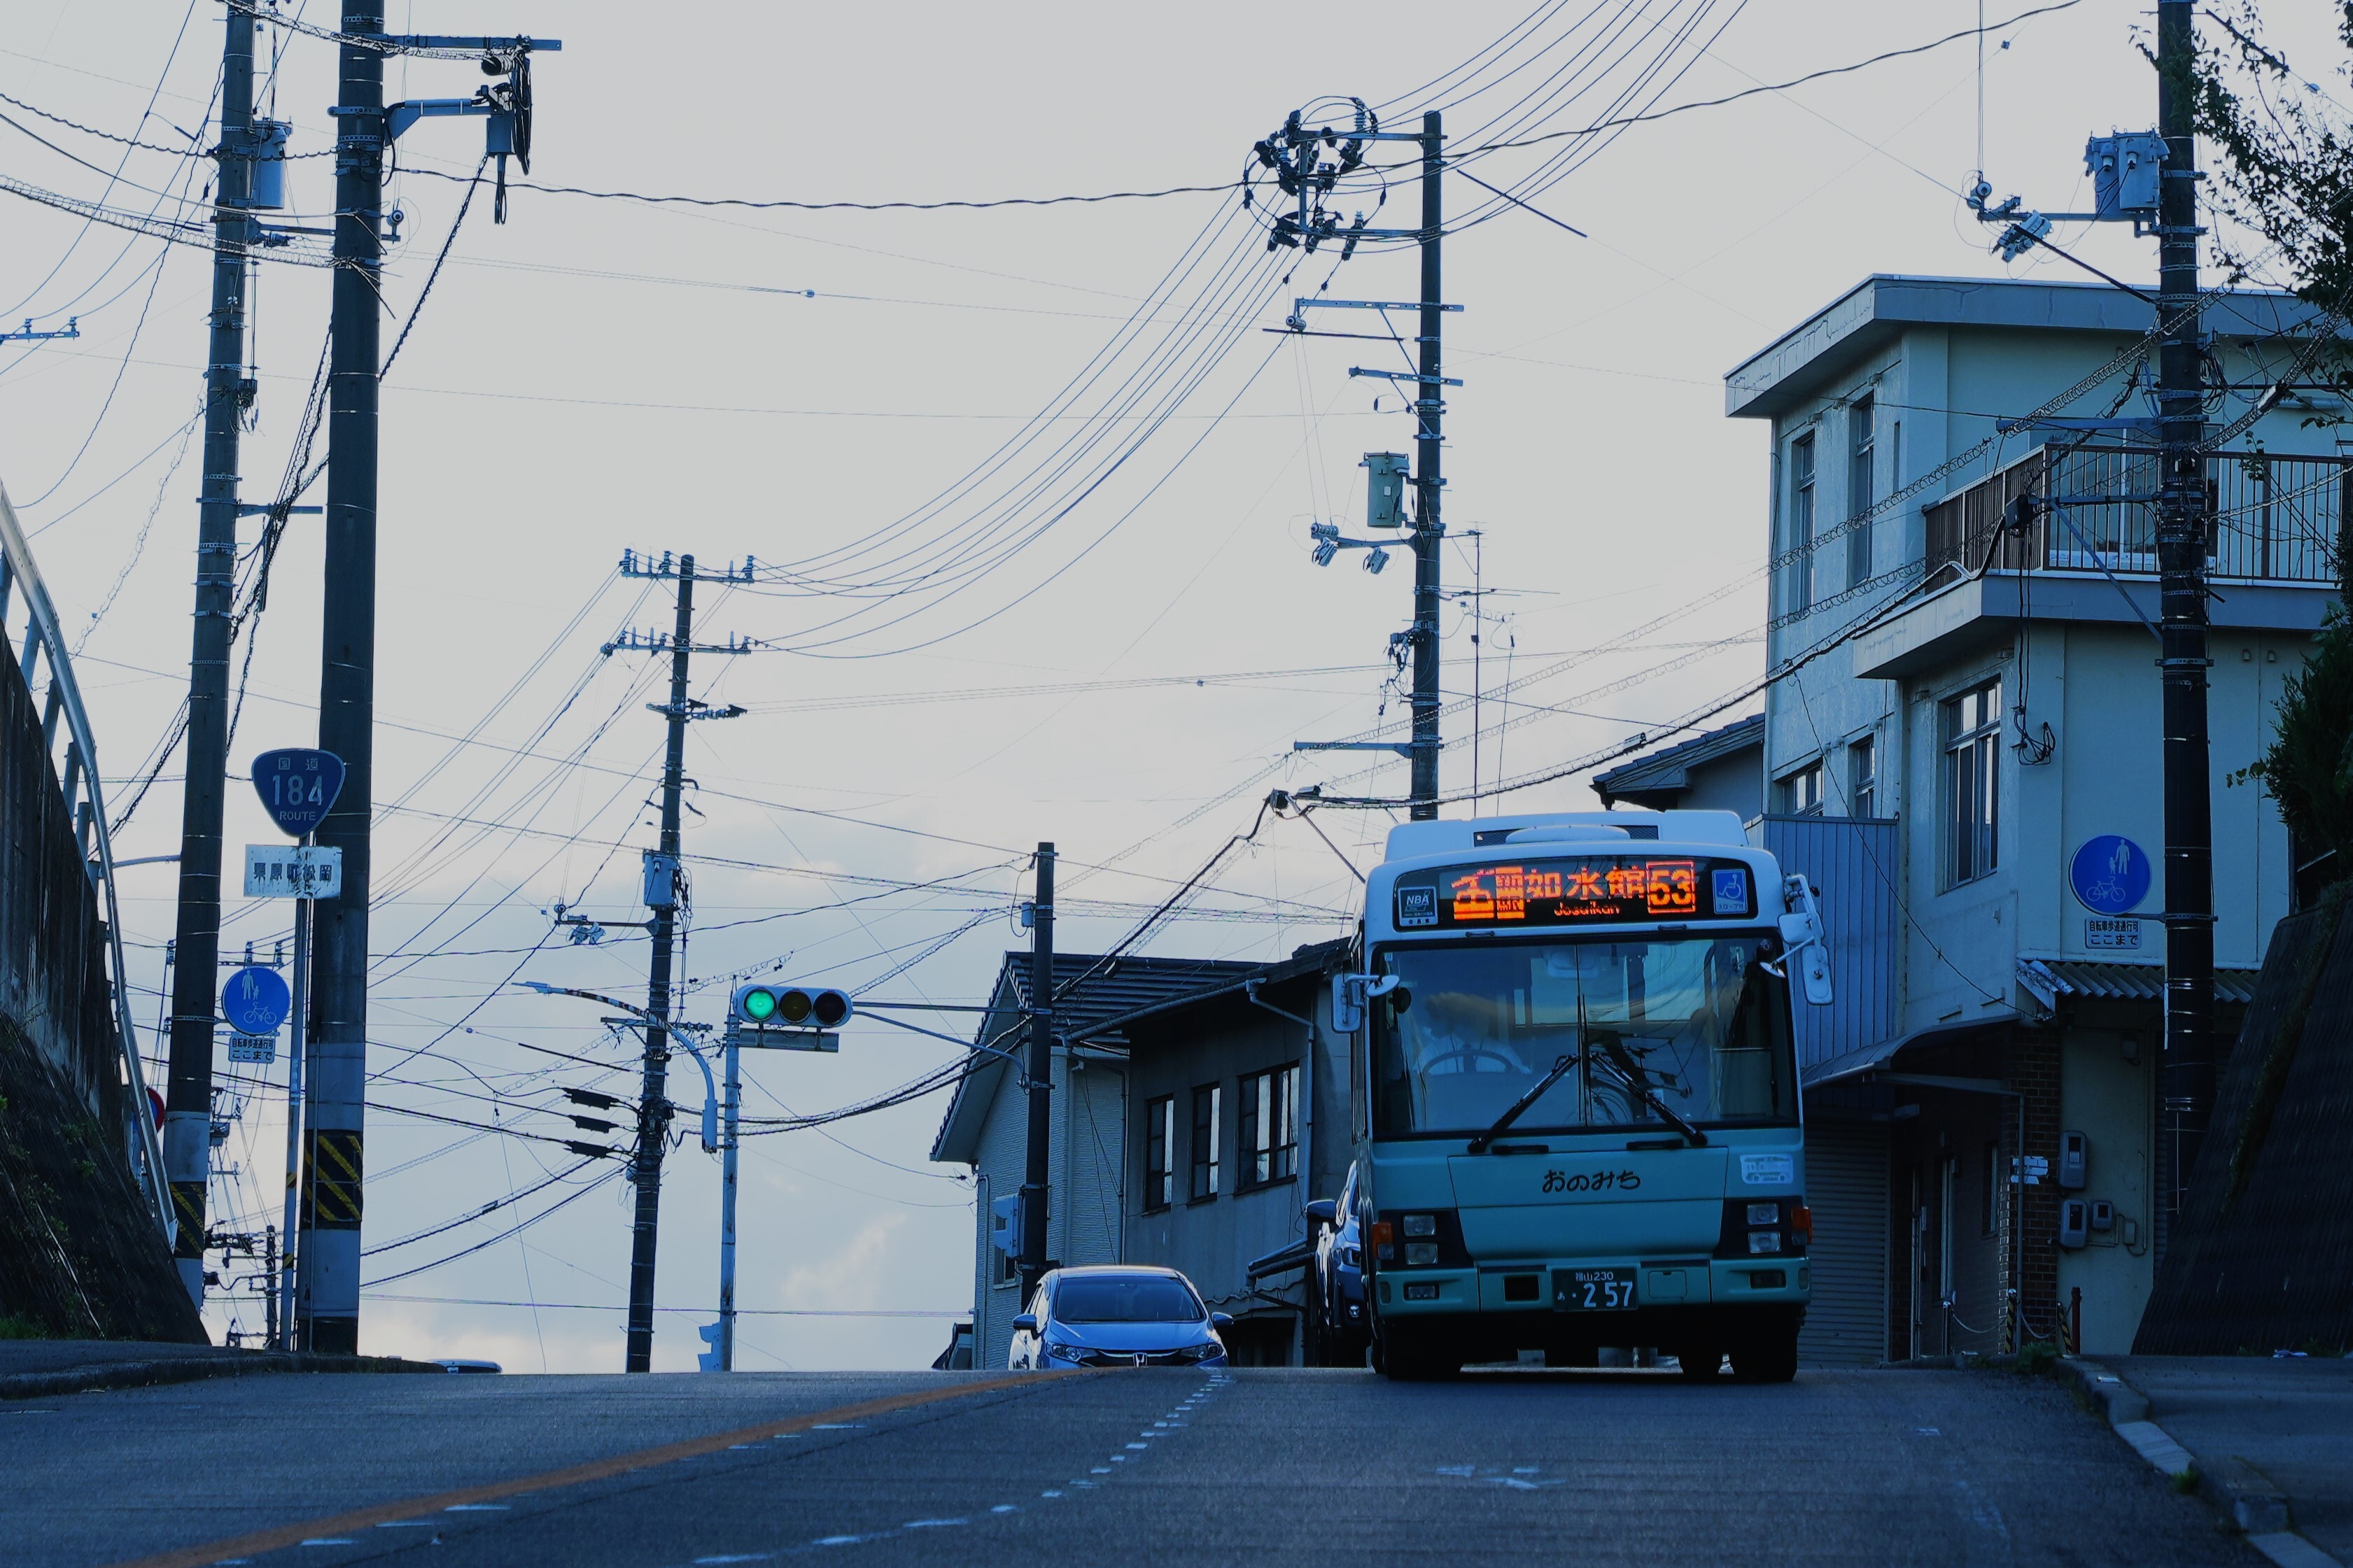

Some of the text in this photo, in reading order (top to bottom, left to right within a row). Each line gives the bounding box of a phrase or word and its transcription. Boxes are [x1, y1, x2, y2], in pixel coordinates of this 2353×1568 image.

[279, 758, 318, 770] 国道
[272, 775, 323, 805] 184
[280, 812, 316, 821] ROUTE
[1649, 870, 1692, 905] 53
[1407, 895, 1429, 905] NBA
[2089, 919, 2139, 933] 自転車歩道通行可
[2091, 934, 2139, 945] ここまで
[232, 1050, 273, 1061] ここまで
[1541, 1169, 1641, 1194] おのみち
